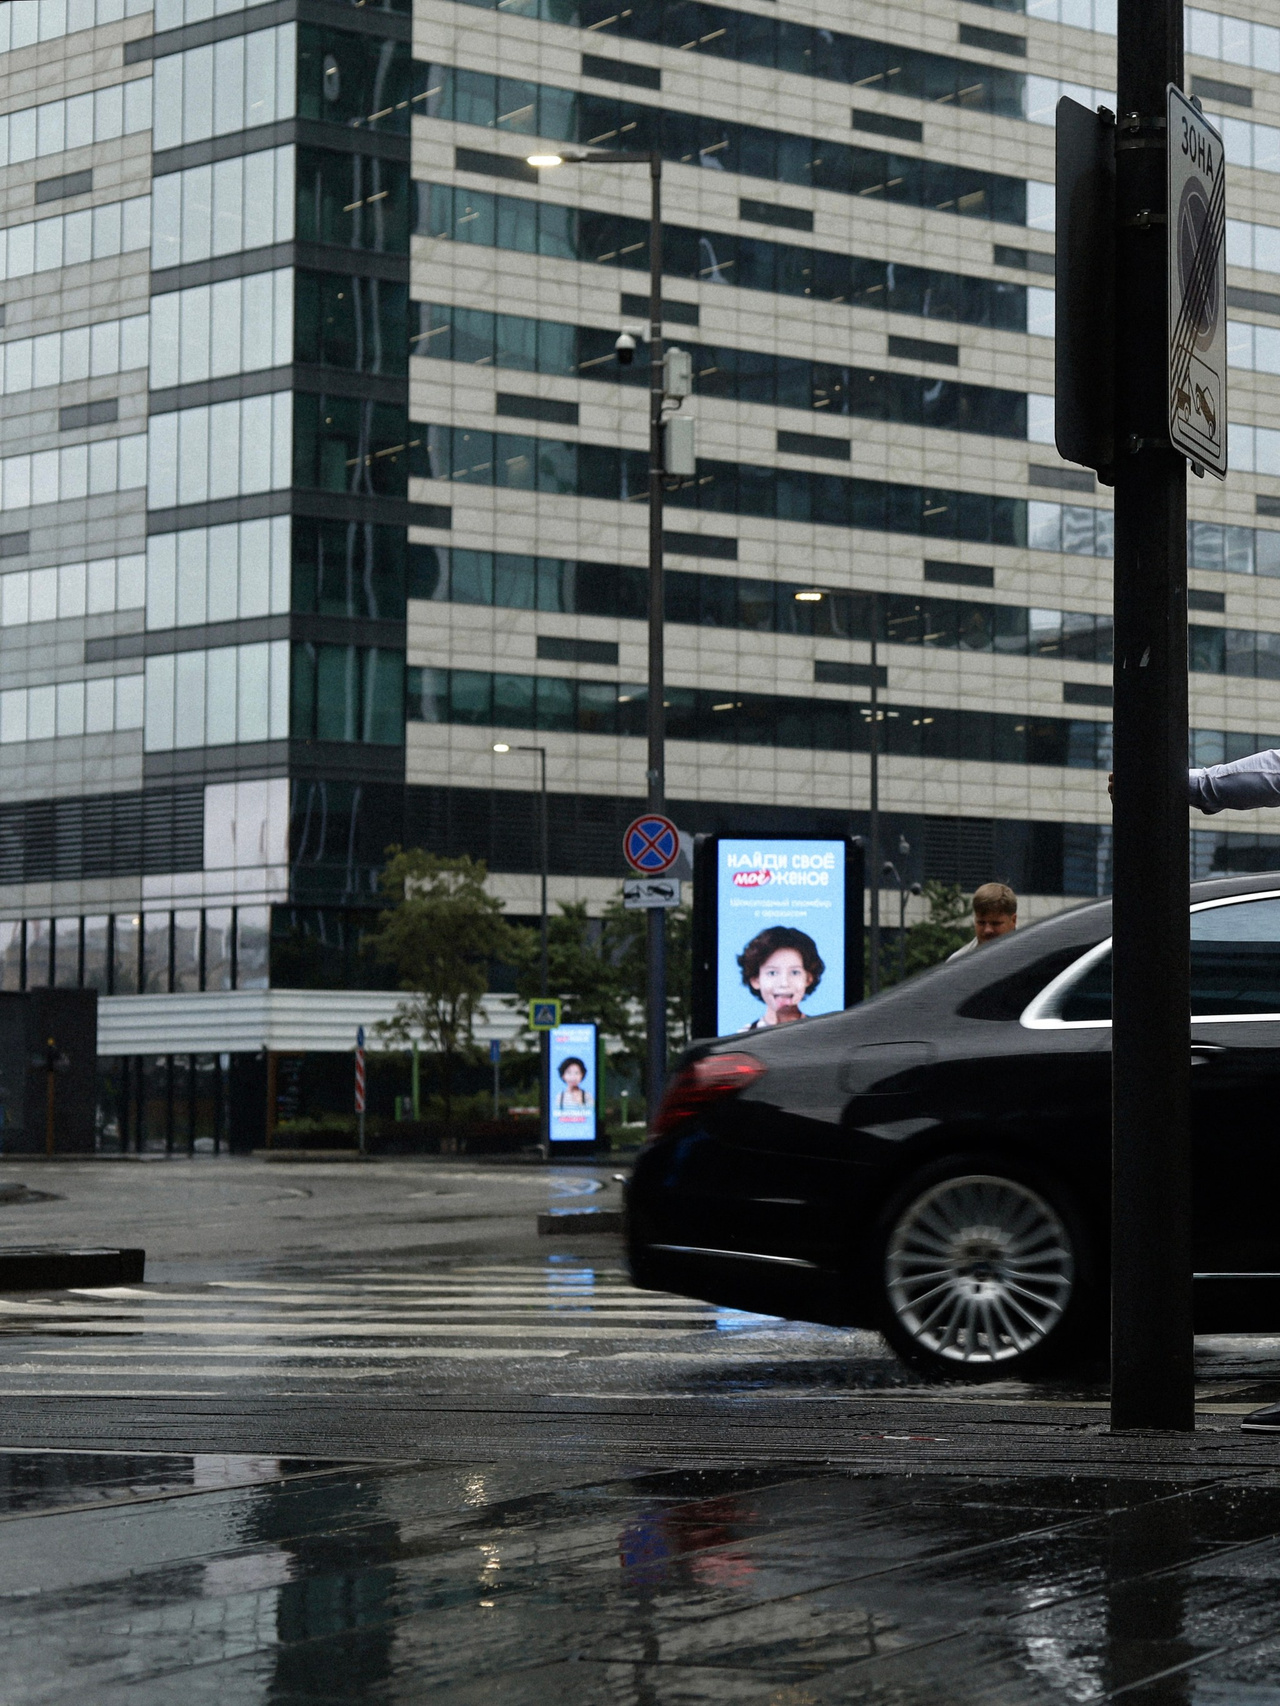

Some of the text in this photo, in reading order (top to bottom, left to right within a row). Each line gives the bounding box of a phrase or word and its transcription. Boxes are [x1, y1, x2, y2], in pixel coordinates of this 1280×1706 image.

[1181, 116, 1214, 182] ЗОНА
[727, 851, 836, 870] НАЙДИ СВОЁ
